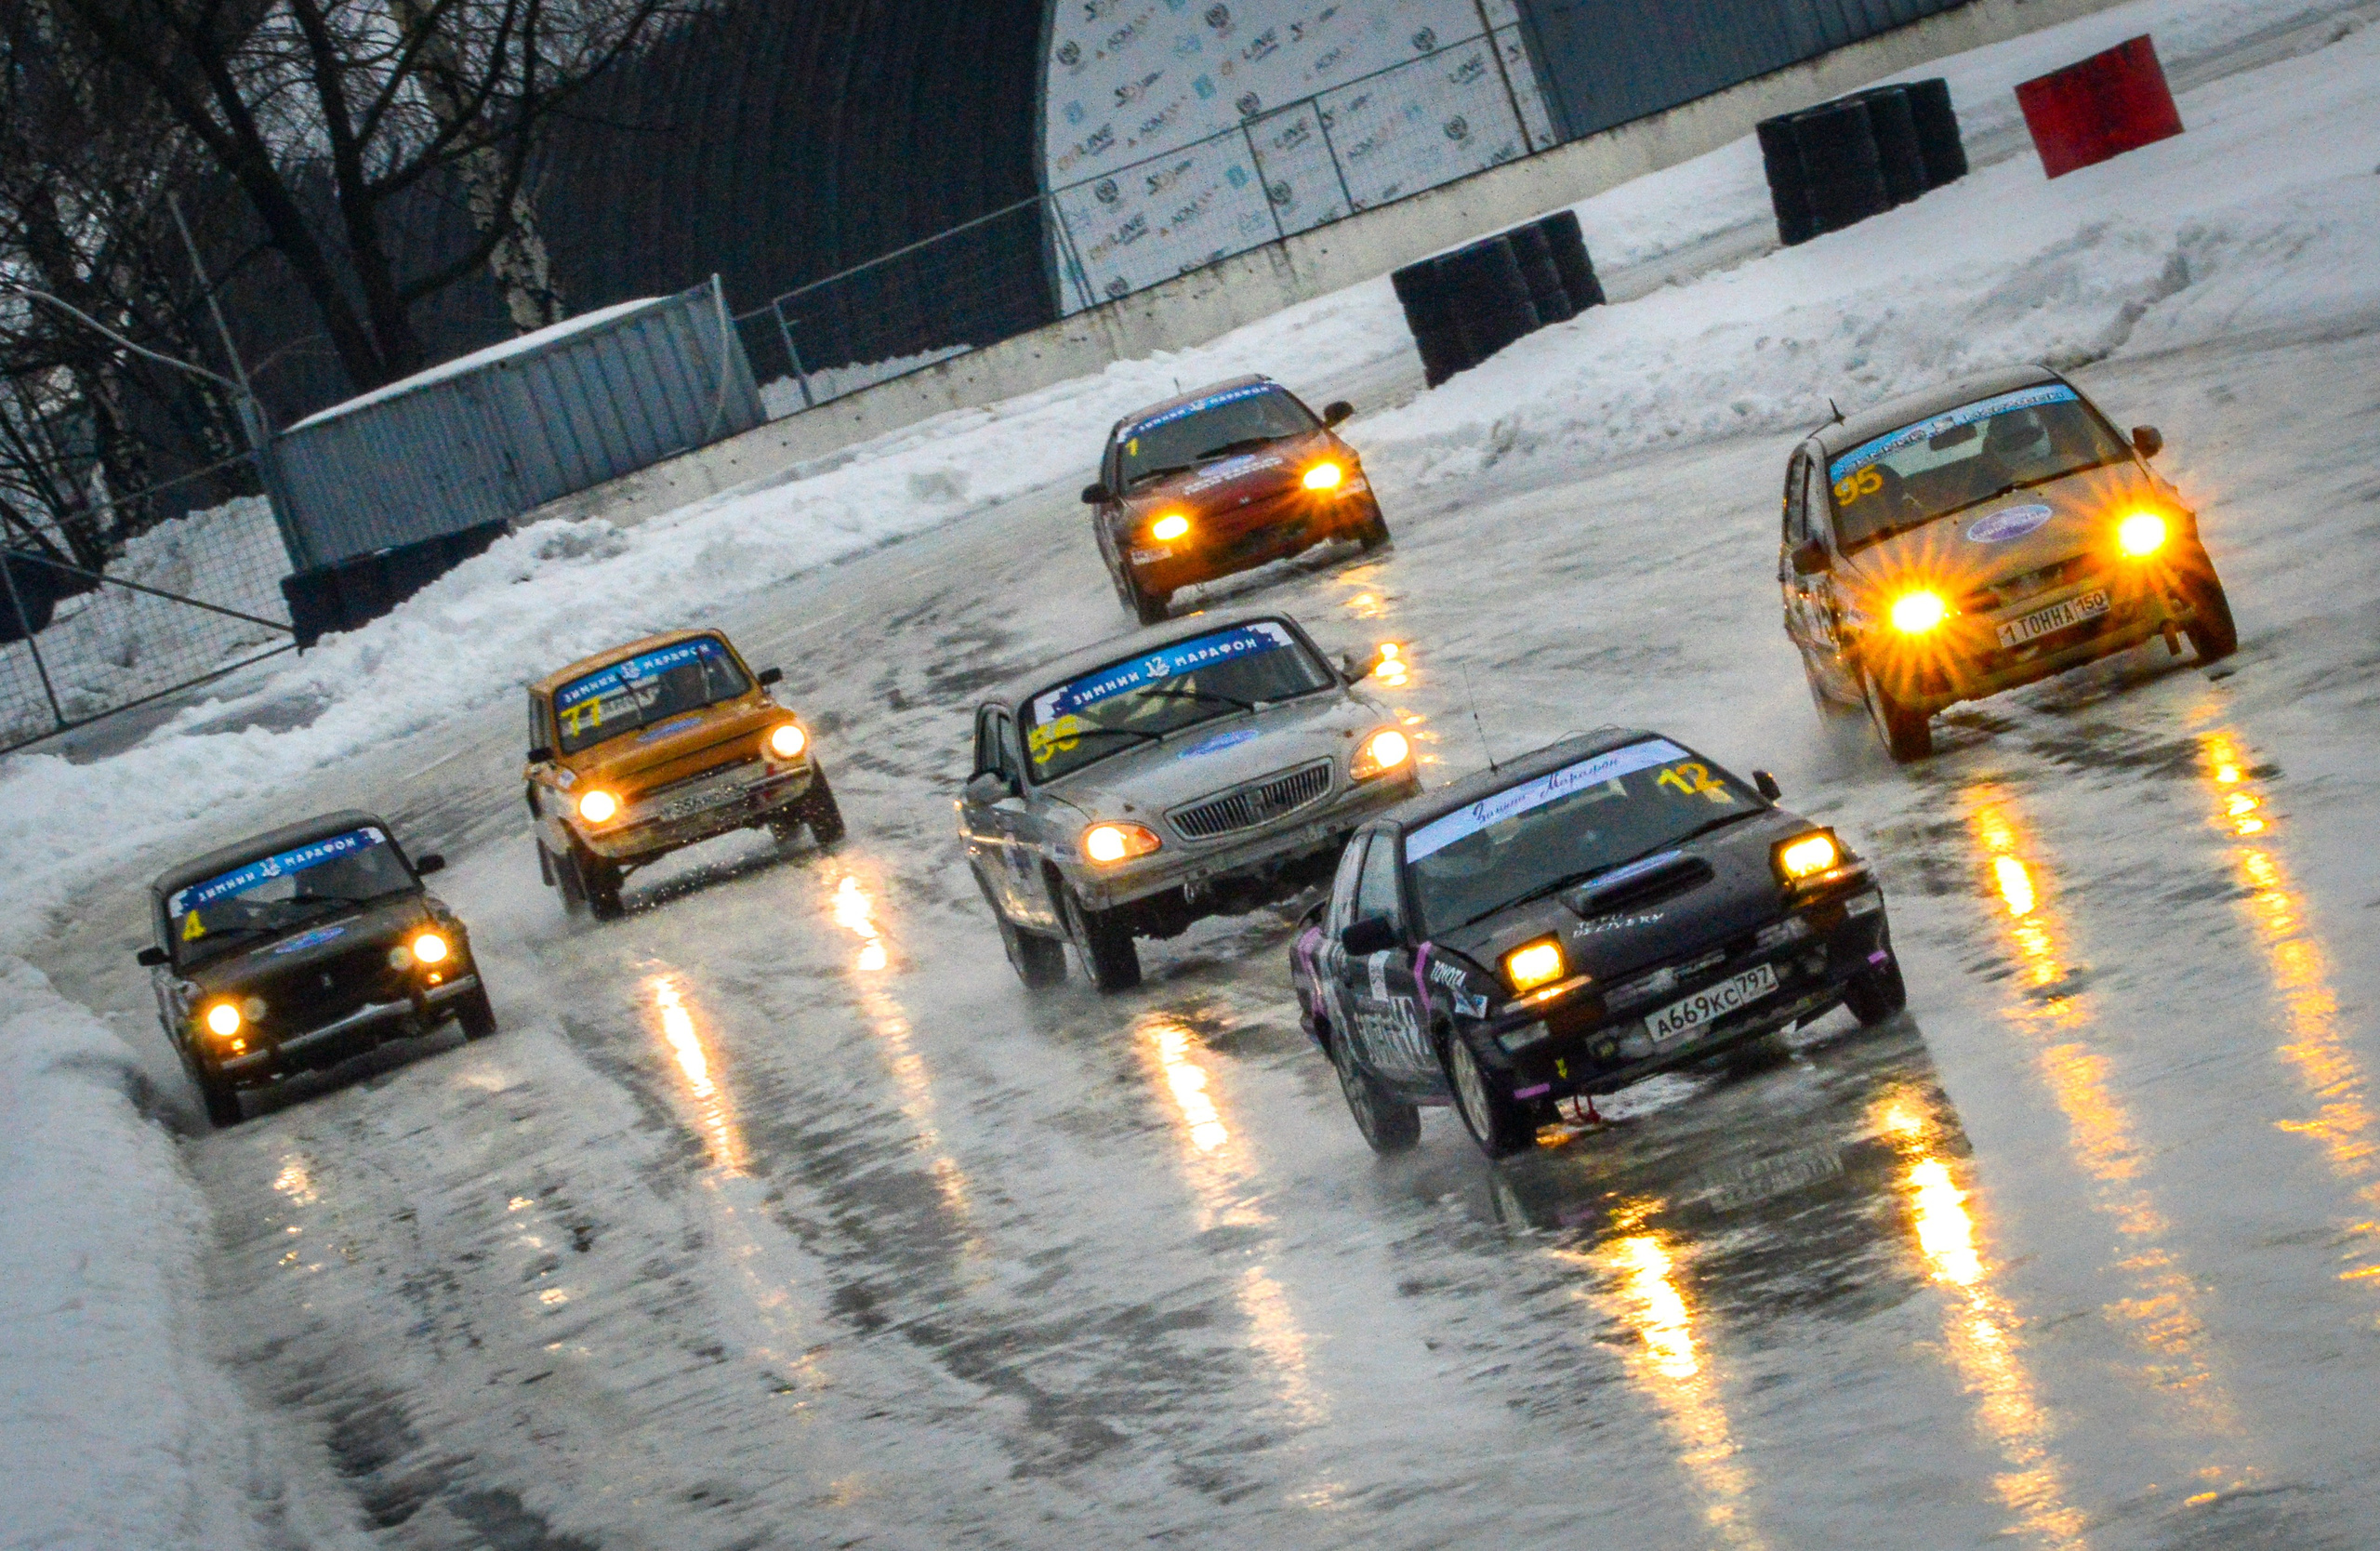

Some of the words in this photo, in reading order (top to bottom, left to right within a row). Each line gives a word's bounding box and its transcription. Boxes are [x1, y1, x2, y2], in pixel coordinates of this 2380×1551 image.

[1125, 437, 1139, 457] 1
[1833, 464, 1884, 506] 95
[2076, 592, 2104, 613] 150
[1173, 638, 1258, 667] МАРАФОН
[561, 697, 601, 736] 77
[1657, 762, 1725, 794] 12
[182, 909, 207, 941] 4
[1430, 960, 1468, 987] TOYOTA
[1657, 988, 1739, 1037] А669КС
[1736, 967, 1769, 993] 797
